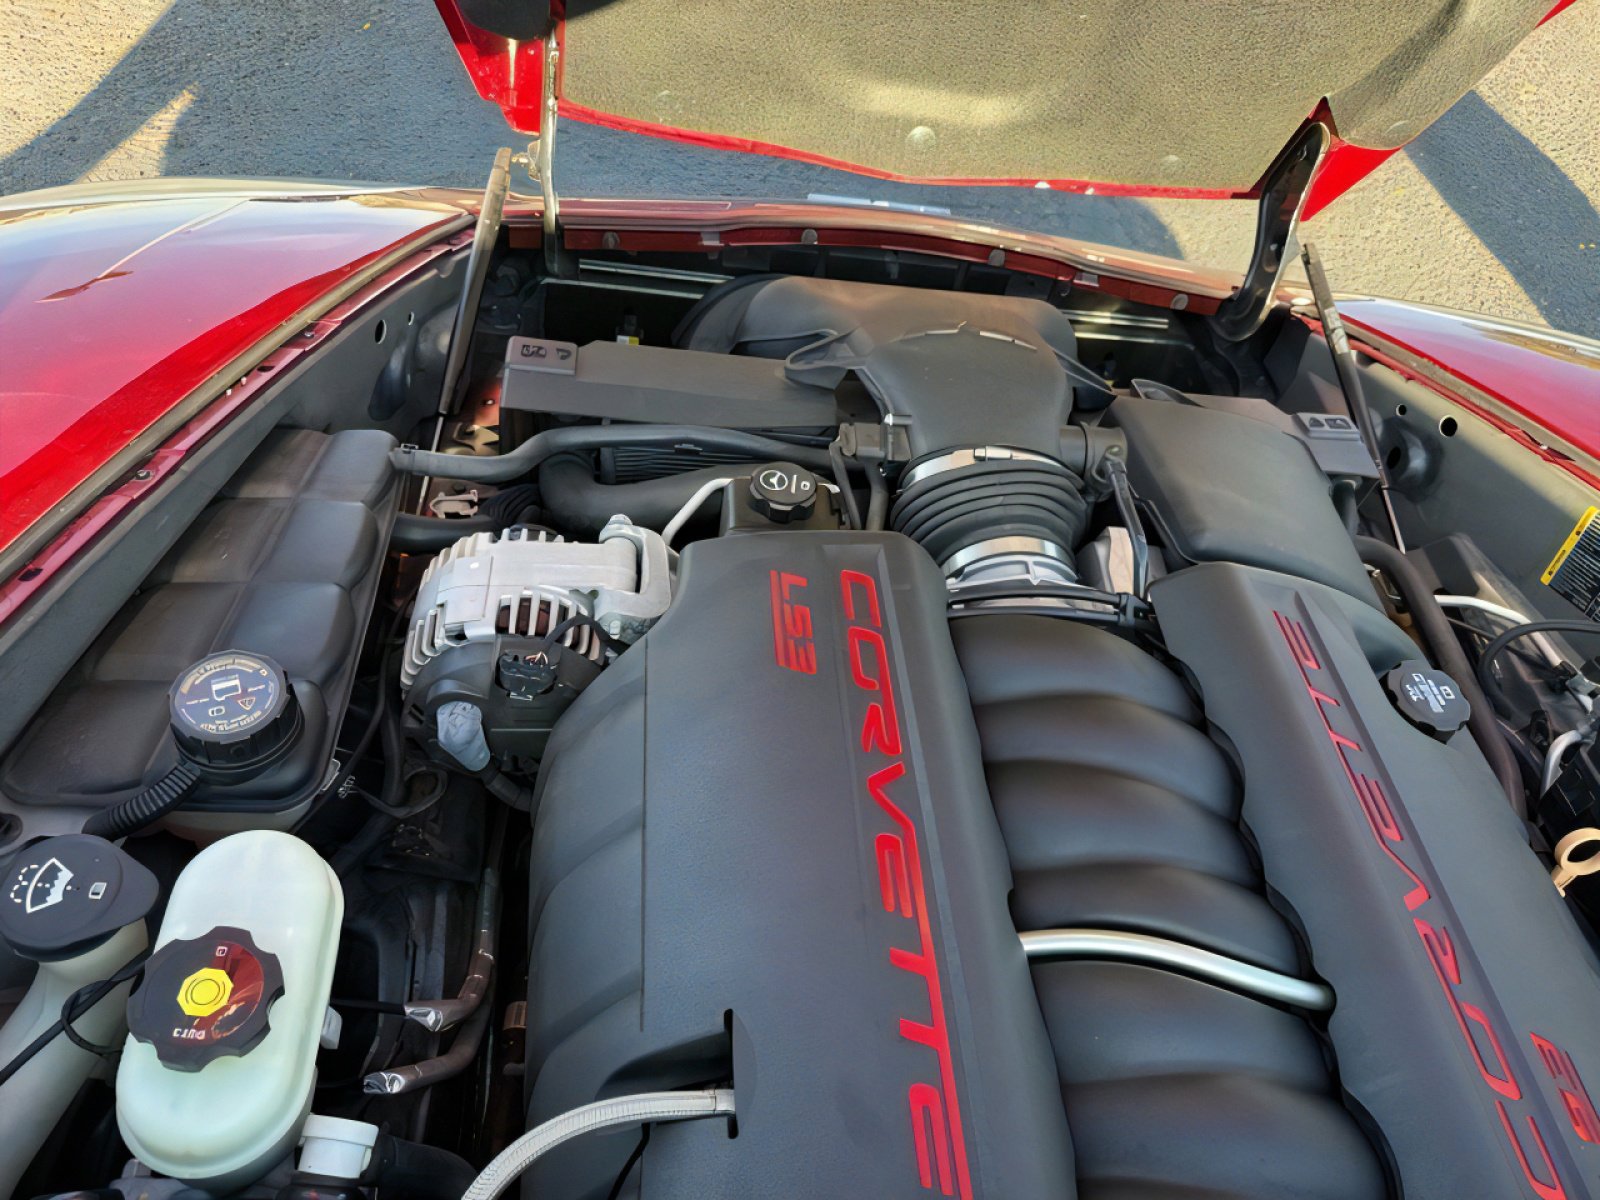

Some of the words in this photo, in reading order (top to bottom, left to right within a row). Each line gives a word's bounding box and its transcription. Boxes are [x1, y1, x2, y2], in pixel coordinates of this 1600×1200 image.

[769, 569, 818, 675] LS3
[839, 568, 974, 1200] CORVETTE
[1272, 609, 1568, 1200] CORVETTE
